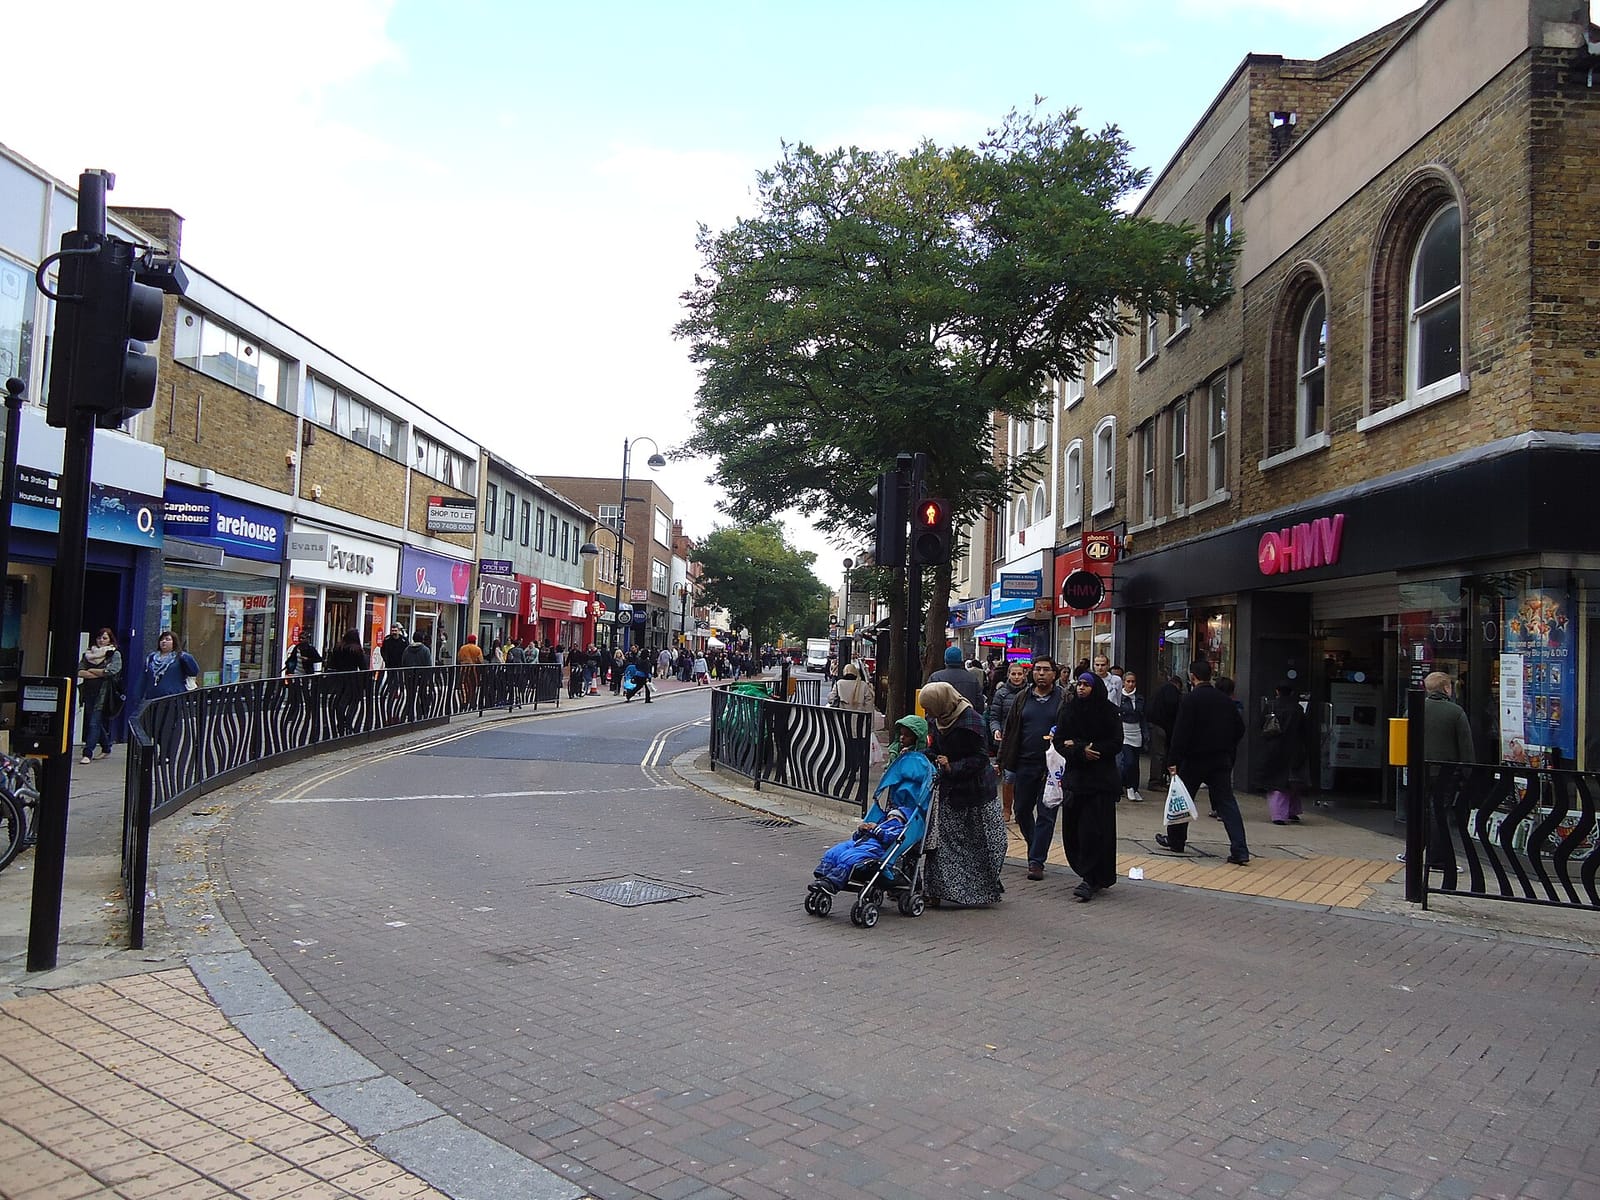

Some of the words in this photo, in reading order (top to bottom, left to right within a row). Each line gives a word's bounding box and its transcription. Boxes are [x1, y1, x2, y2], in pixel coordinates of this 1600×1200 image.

[30, 475, 48, 486] Station
[216, 512, 277, 543] arehouse
[291, 542, 324, 552] Evans
[1279, 514, 1345, 574] HMV
[328, 544, 375, 576] Evans
[1066, 585, 1098, 597] HMV
